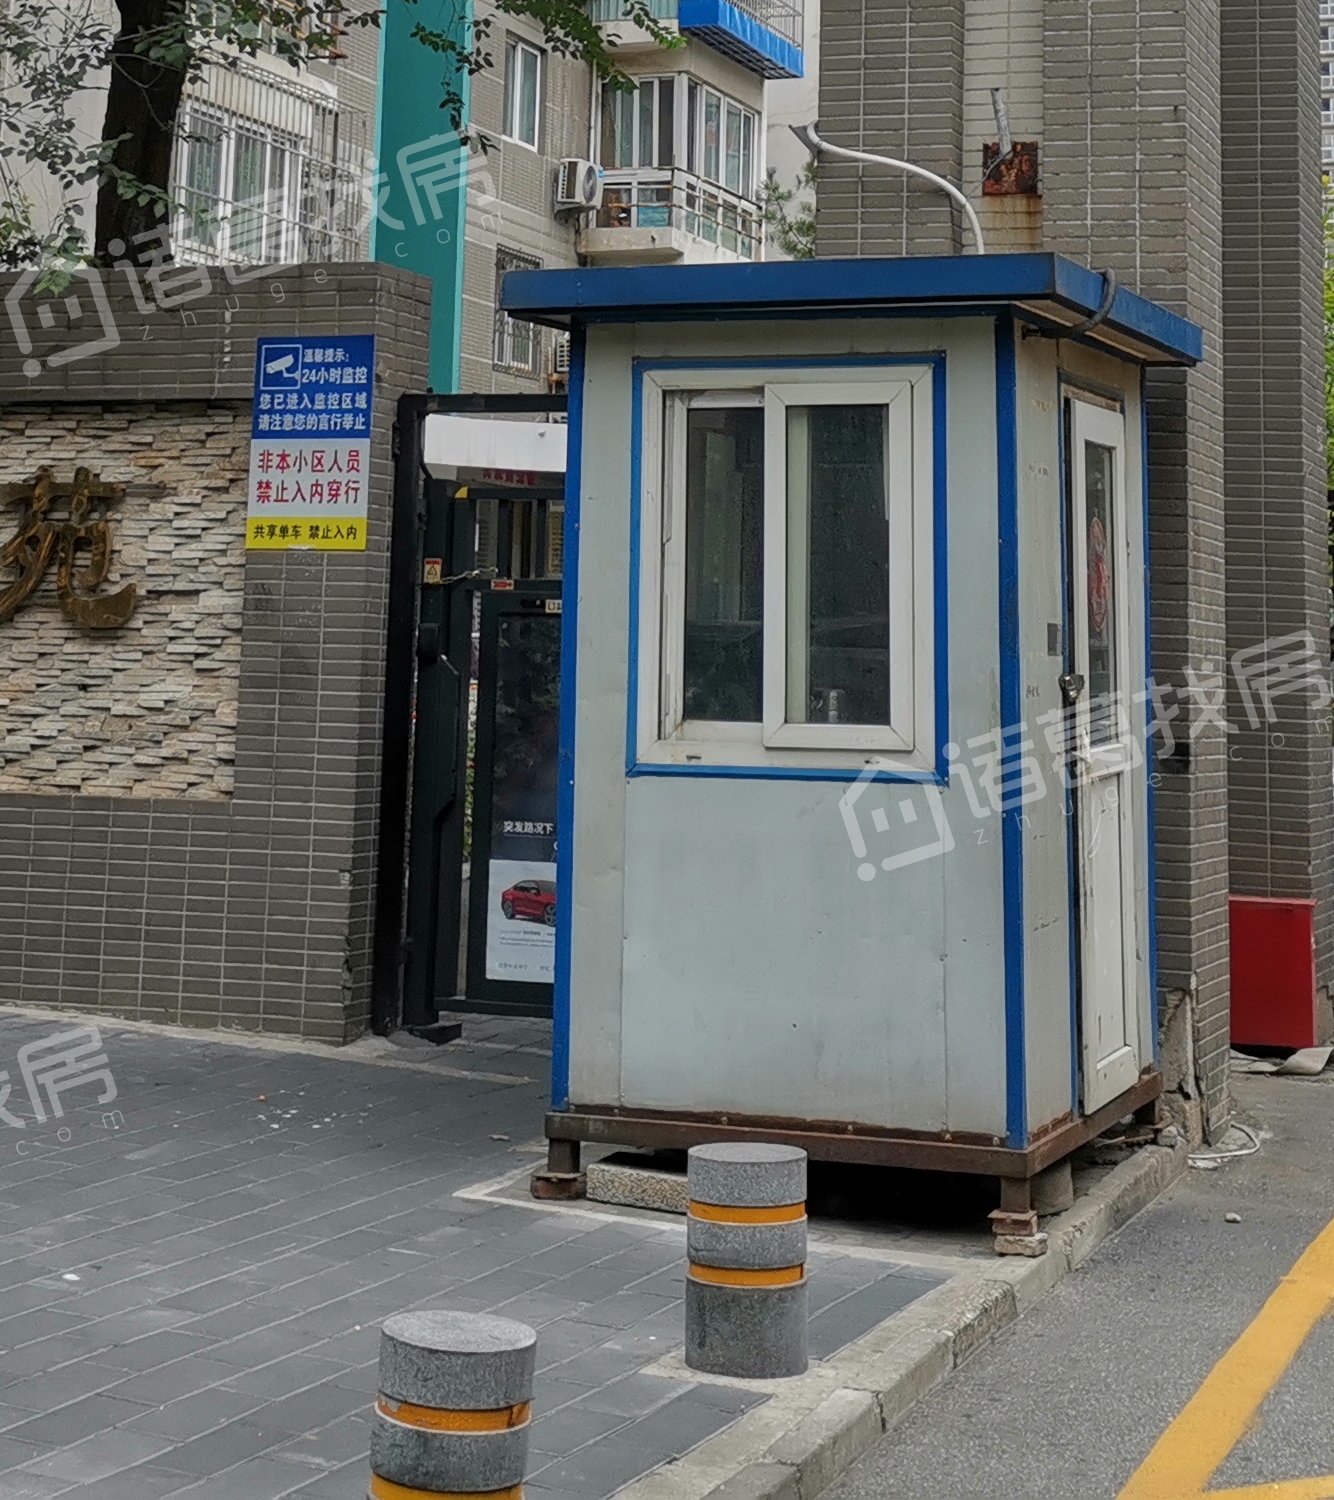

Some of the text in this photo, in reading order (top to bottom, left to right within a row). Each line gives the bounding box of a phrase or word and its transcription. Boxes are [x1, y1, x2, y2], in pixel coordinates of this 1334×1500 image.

[302, 366, 368, 384] 24小时监控
[258, 391, 368, 410] 您已进入监控区域
[258, 413, 366, 431] 请注意您的言行举止
[257, 449, 361, 474] 非本小区人员
[256, 479, 360, 504] 禁止入内穿行
[253, 524, 357, 541] 共享单车 禁止入内
[503, 820, 554, 835] 突发路况下
